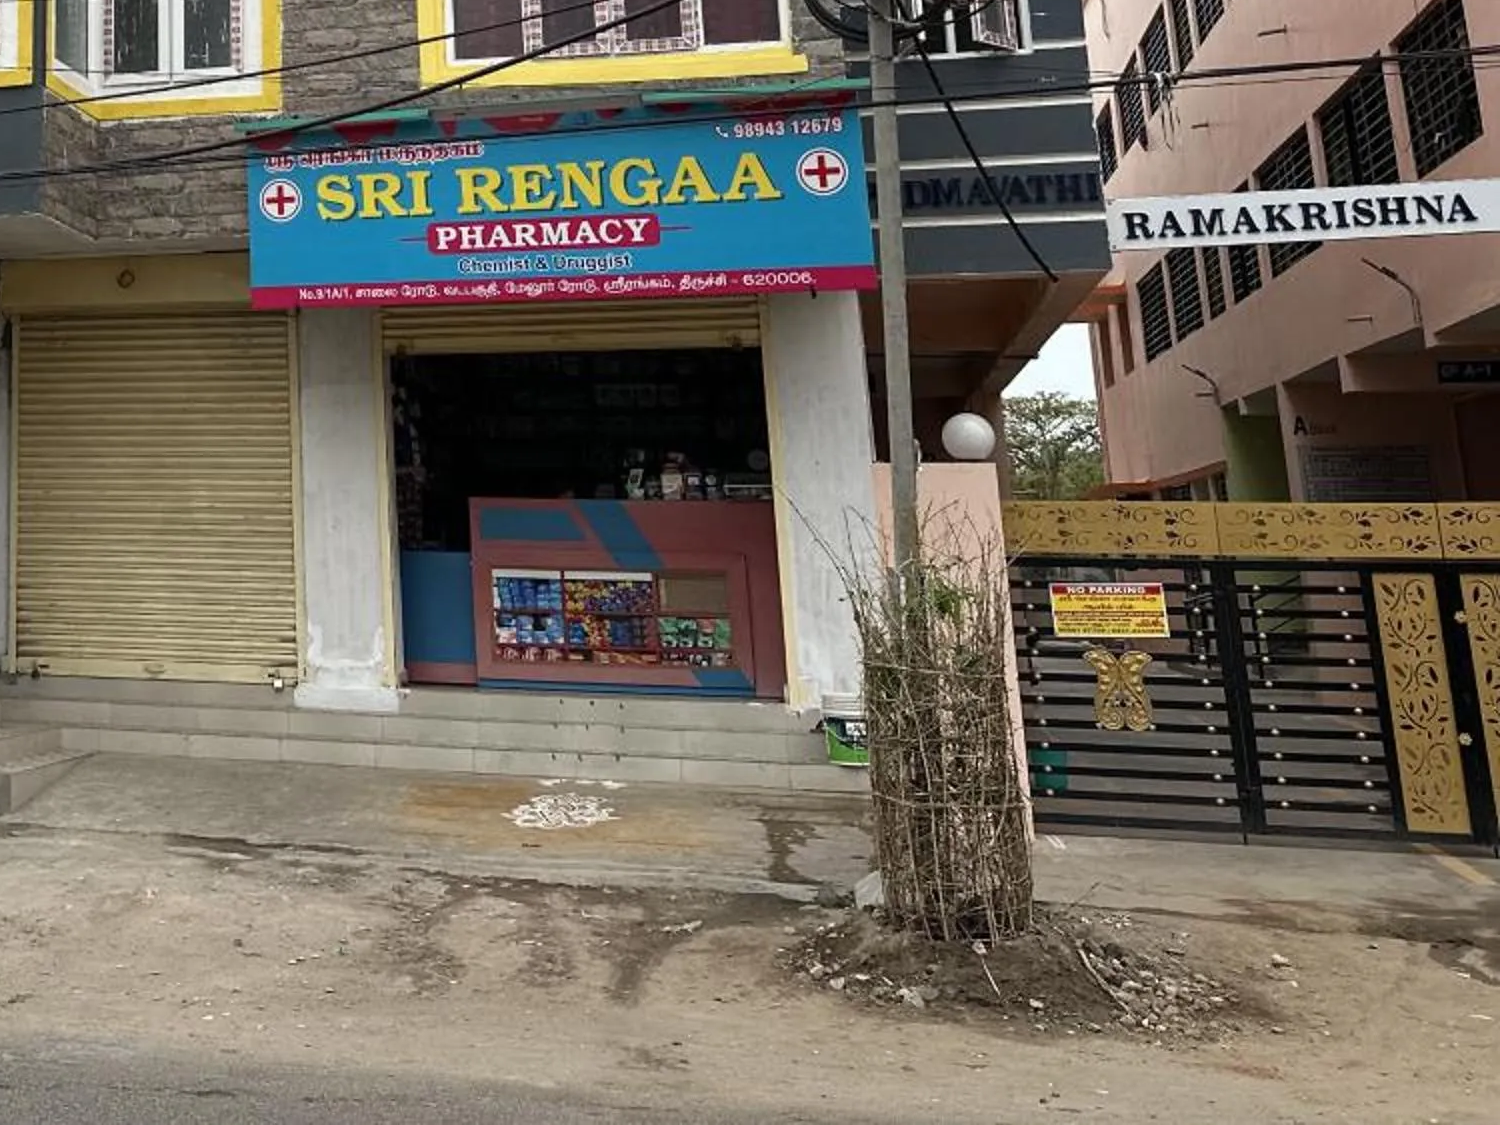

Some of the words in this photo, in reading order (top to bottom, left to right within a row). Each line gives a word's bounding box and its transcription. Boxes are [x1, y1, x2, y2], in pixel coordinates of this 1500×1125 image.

[733, 120, 785, 138] 98943
[790, 116, 843, 134] 12679
[317, 171, 434, 221] SRI
[456, 152, 784, 214] RENGAA
[1122, 192, 1479, 241] RAMAKRISHNA
[436, 219, 650, 250] PHARMACY
[458, 256, 530, 274] Chemist
[534, 255, 550, 272] &
[553, 251, 632, 273] Druggist
[1067, 586, 1085, 594] NO
[1089, 586, 1147, 594] PARKING
